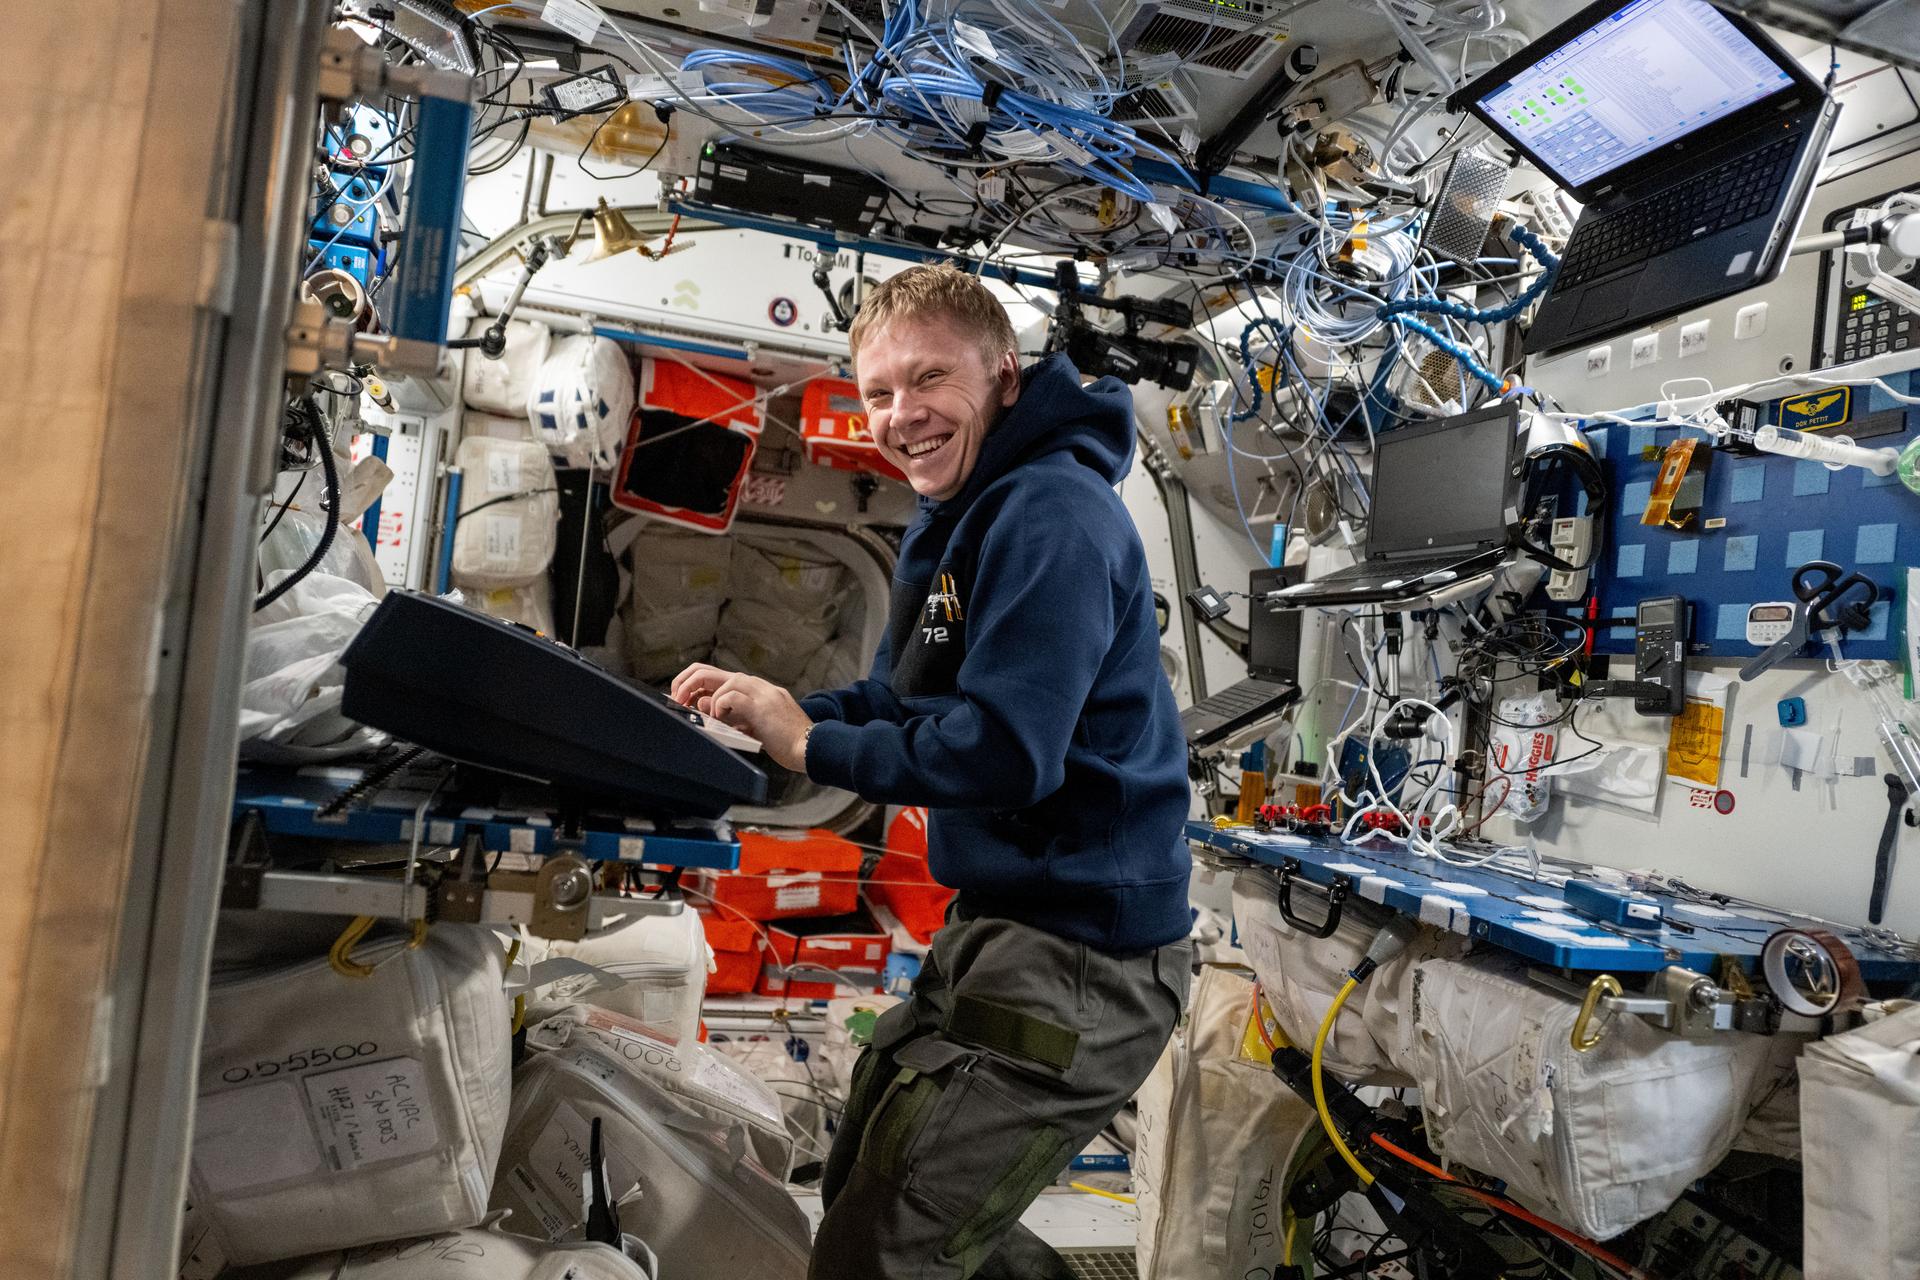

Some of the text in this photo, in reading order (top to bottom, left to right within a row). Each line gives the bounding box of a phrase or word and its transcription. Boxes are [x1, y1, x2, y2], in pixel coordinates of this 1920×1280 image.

[796, 245, 812, 262] To
[1809, 415, 1829, 425] PETTIT
[922, 626, 949, 644] 72
[1525, 732, 1545, 782] HUGGIES
[362, 1089, 390, 1120] S/N
[384, 1073, 420, 1129] AC VAC
